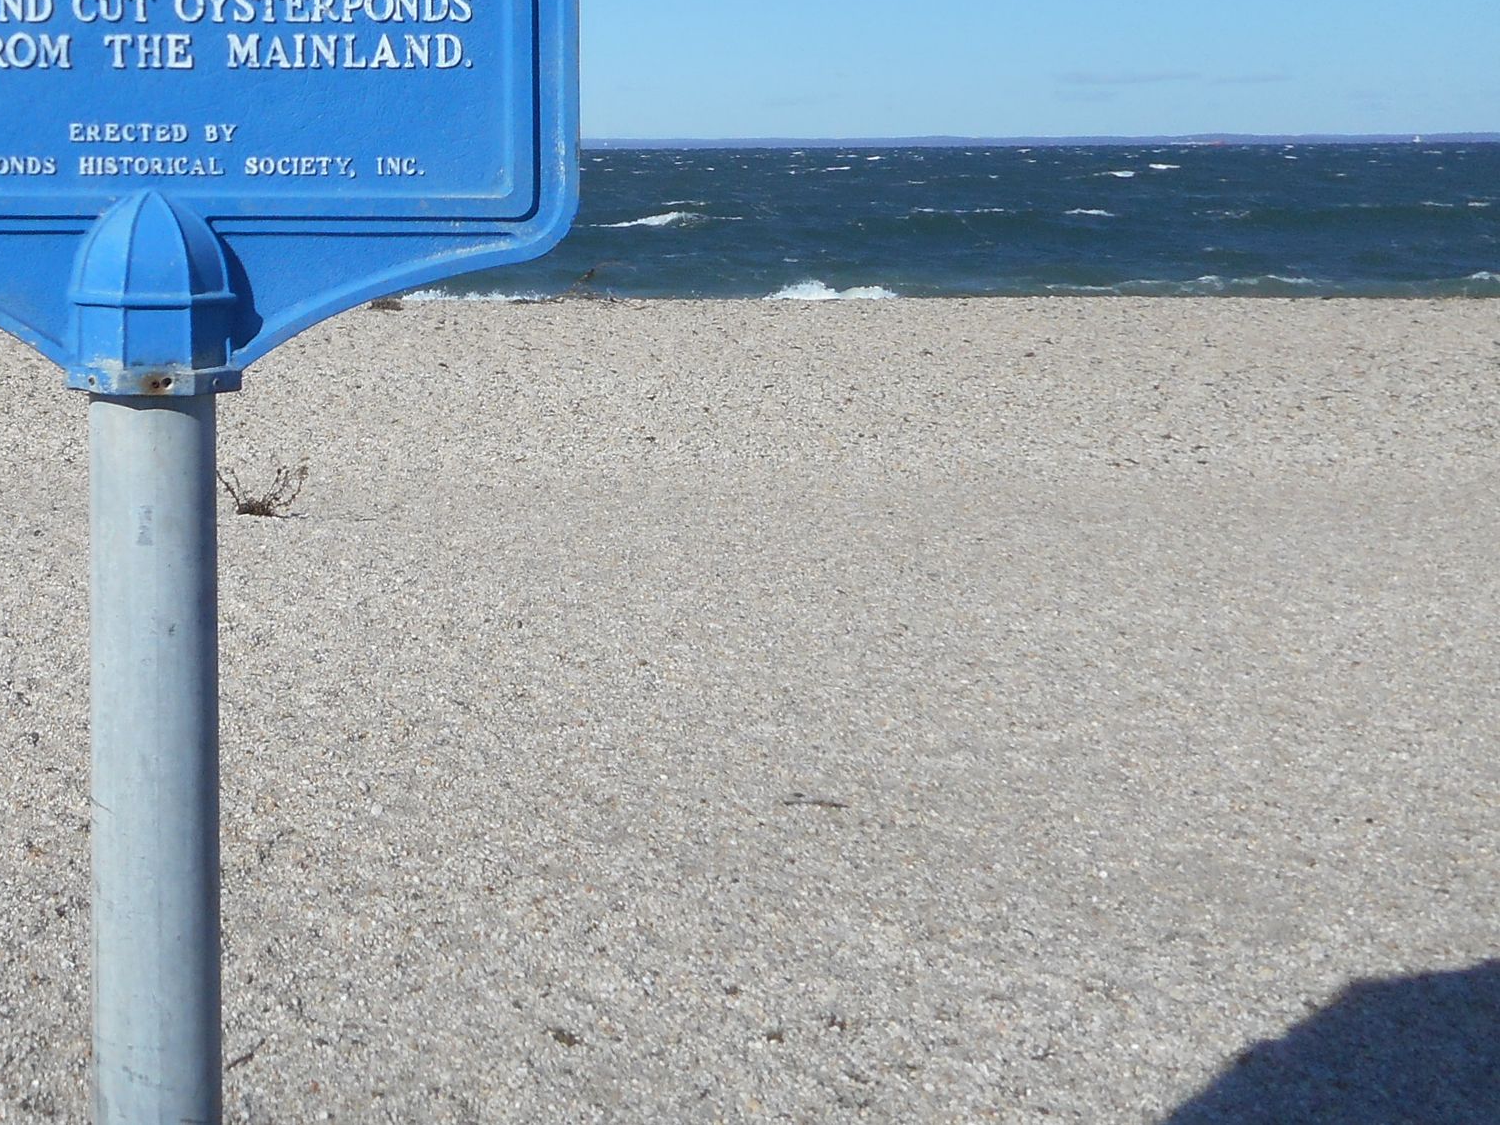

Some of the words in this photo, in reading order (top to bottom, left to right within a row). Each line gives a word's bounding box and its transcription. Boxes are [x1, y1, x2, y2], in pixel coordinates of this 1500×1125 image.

[103, 33, 193, 69] THE
[227, 33, 472, 68] MAINLAND.
[69, 122, 187, 142] ERECTED
[204, 123, 236, 142] BY
[79, 156, 224, 175] HISTORICAL
[244, 156, 356, 178] SOCIETY,
[376, 156, 425, 175] INC.
